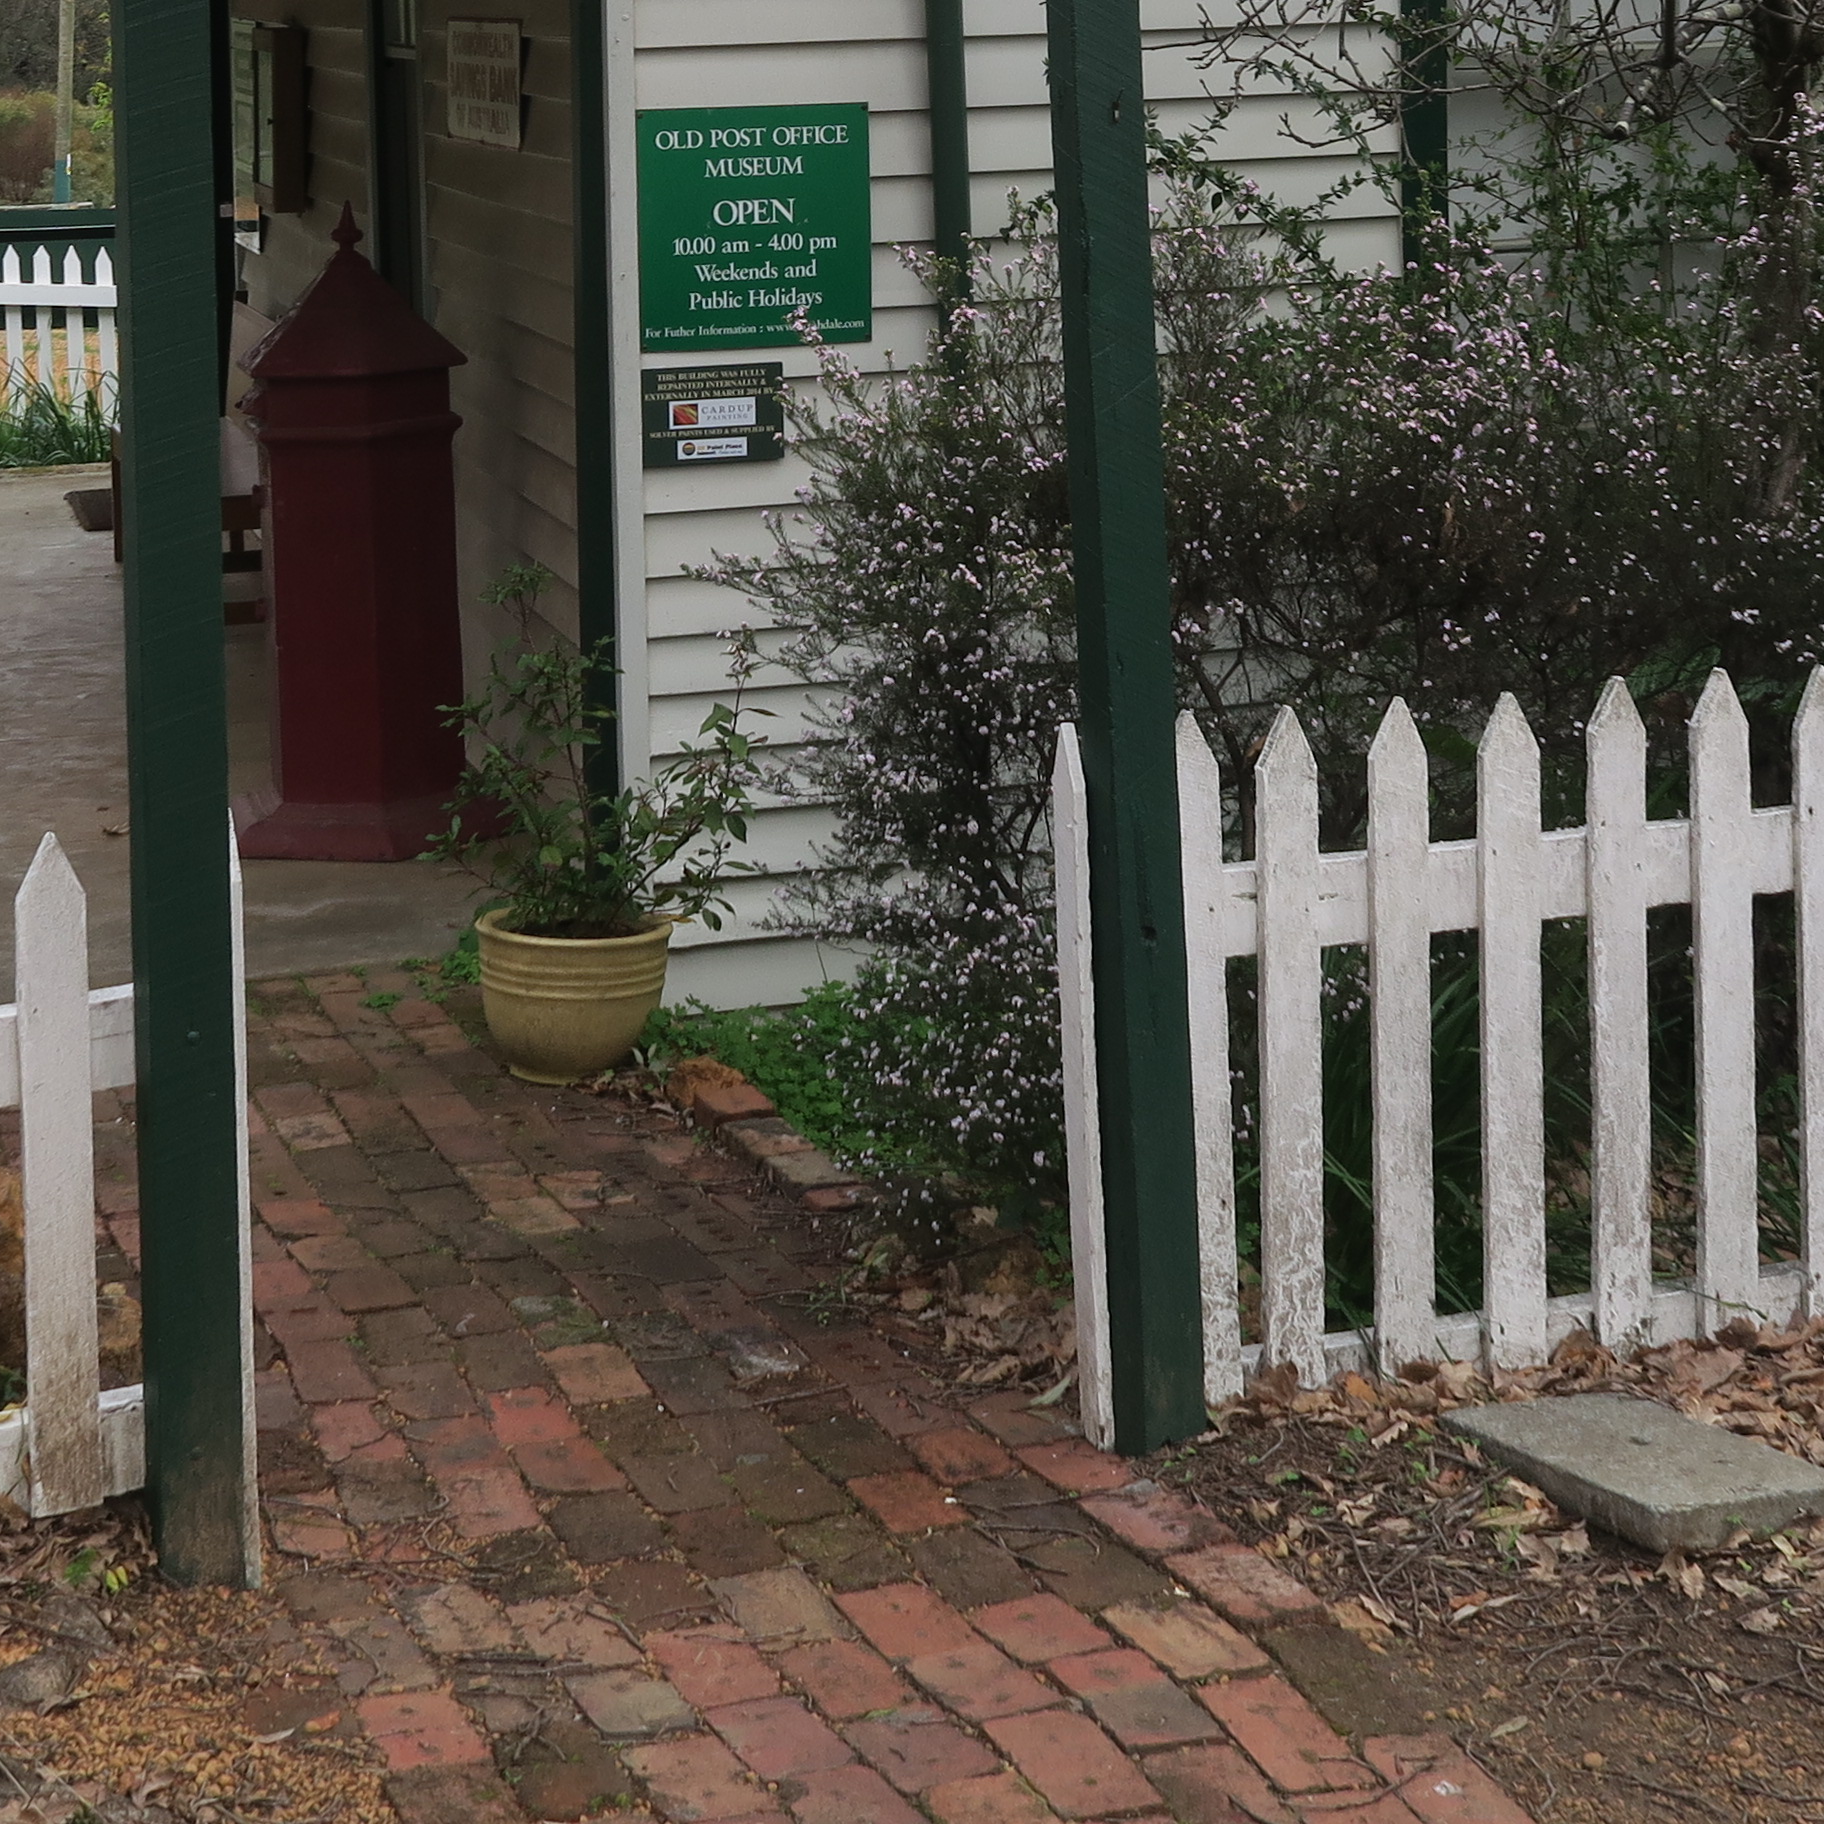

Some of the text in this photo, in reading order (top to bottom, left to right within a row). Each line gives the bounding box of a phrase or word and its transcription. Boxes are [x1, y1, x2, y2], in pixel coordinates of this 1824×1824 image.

[654, 124, 850, 150] OLD POST OFFICE
[703, 155, 805, 178] MUSEUM
[712, 197, 796, 226] OPEN
[672, 236, 716, 256] 10.00
[721, 240, 750, 254] am
[767, 233, 804, 251] 4.00
[808, 235, 838, 255] pm
[693, 258, 818, 282] Weekends and
[688, 287, 823, 310] Public Holidays
[645, 327, 662, 339] For
[664, 325, 696, 338] Futher
[698, 323, 757, 336] Information
[644, 391, 698, 401] EXTERNALLY
[701, 389, 711, 397] IN
[712, 388, 745, 397] MARCH
[657, 381, 704, 391] REPAINTED
[705, 379, 758, 388] INTERNALLY
[701, 404, 753, 414] CARDUP
